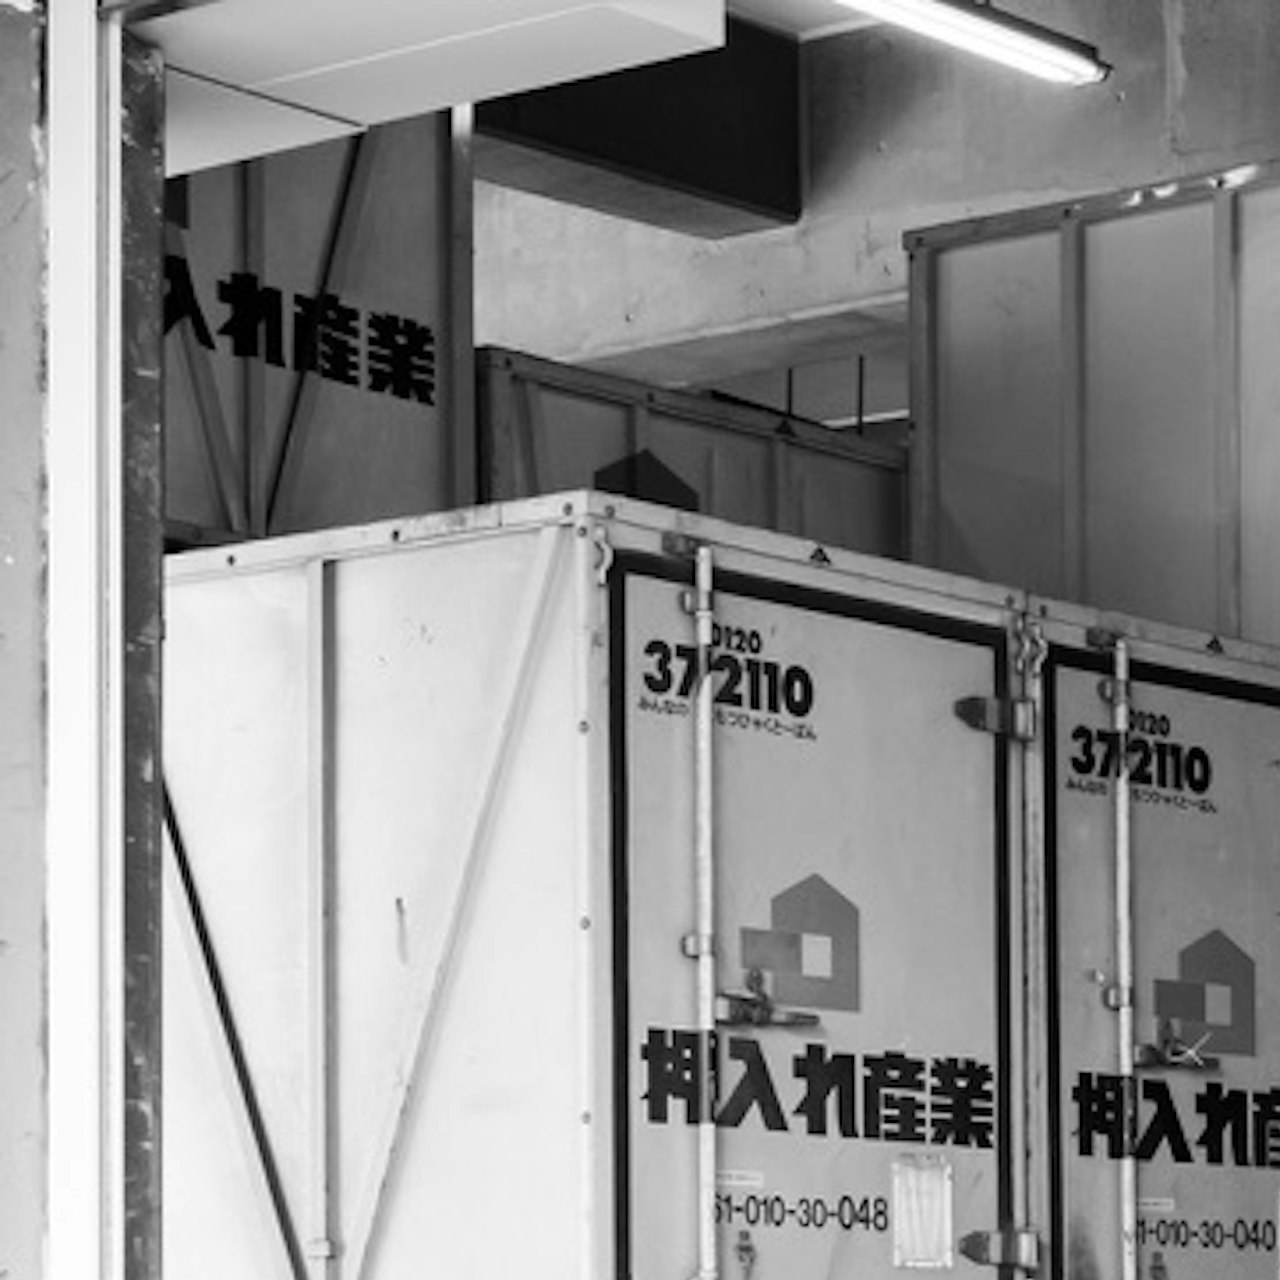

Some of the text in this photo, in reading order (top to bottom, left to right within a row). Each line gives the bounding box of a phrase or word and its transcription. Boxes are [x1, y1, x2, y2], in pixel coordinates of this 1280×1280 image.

[640, 1028, 994, 1149] 押入れ産業
[1135, 1219, 1277, 1251] 1-010-30-040
